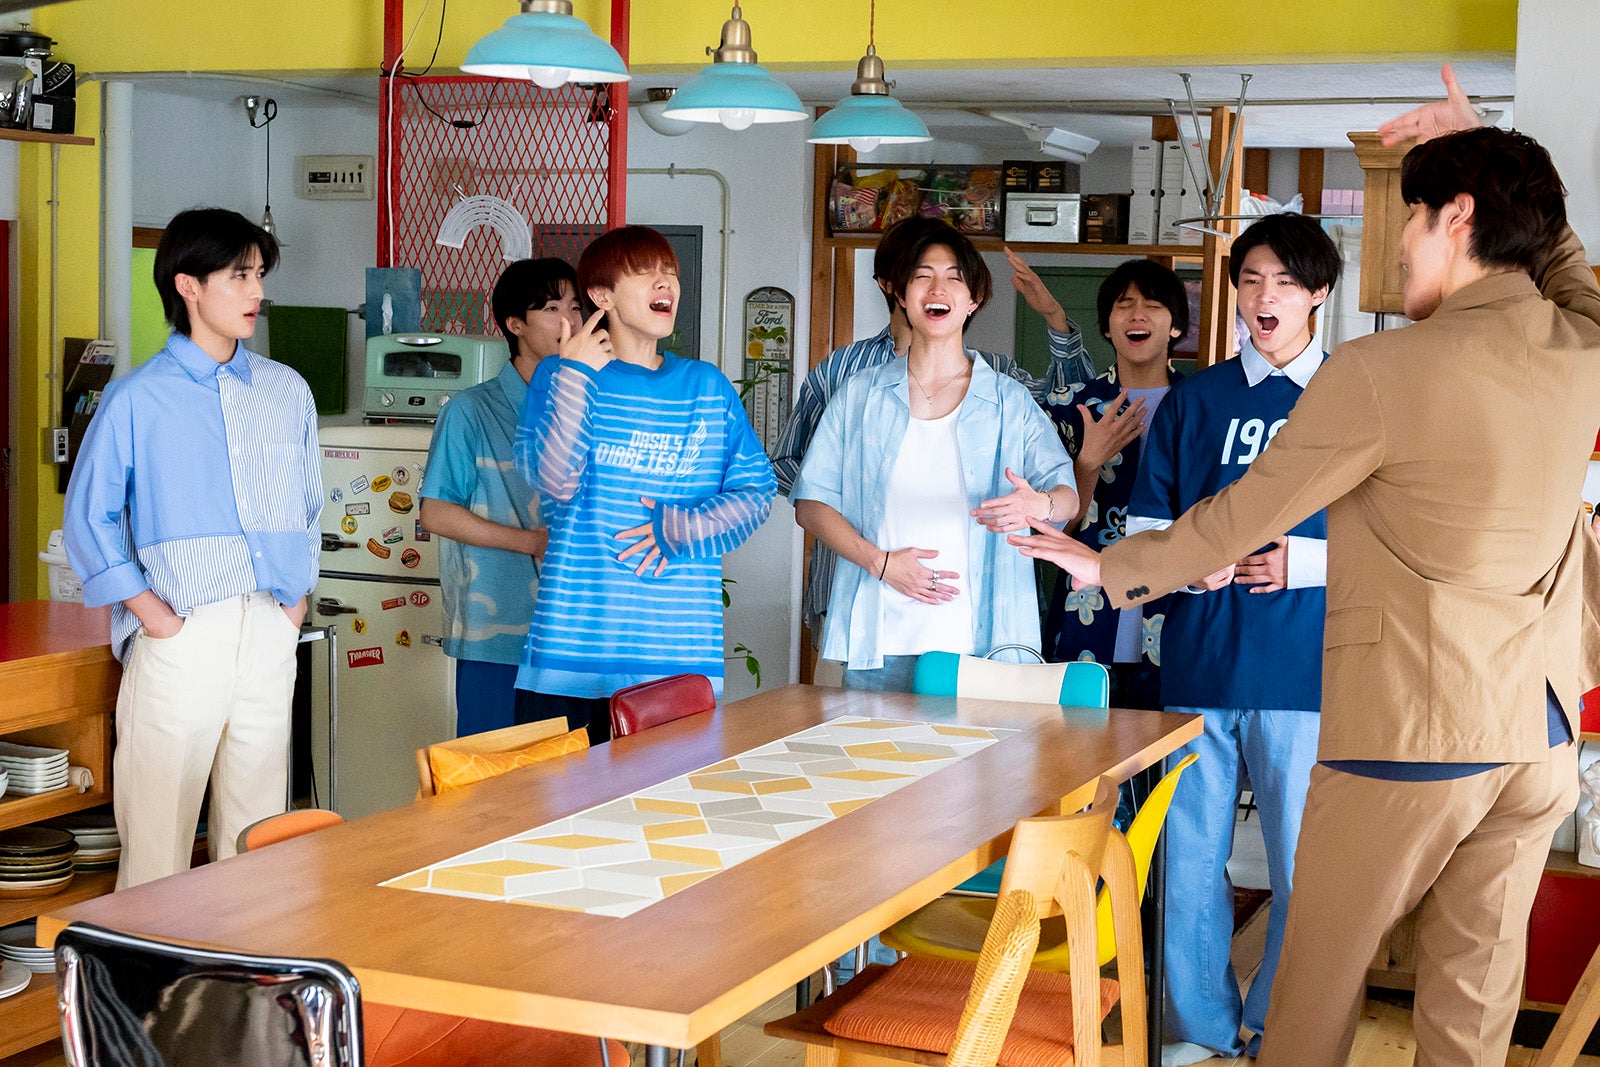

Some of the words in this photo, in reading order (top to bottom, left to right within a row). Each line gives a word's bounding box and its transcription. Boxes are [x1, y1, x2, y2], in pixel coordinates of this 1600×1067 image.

[754, 309, 784, 325] Ford
[629, 430, 671, 451] DASH
[595, 442, 680, 473] DIABETES
[412, 593, 428, 604] STP
[348, 648, 382, 665] THRASHER
